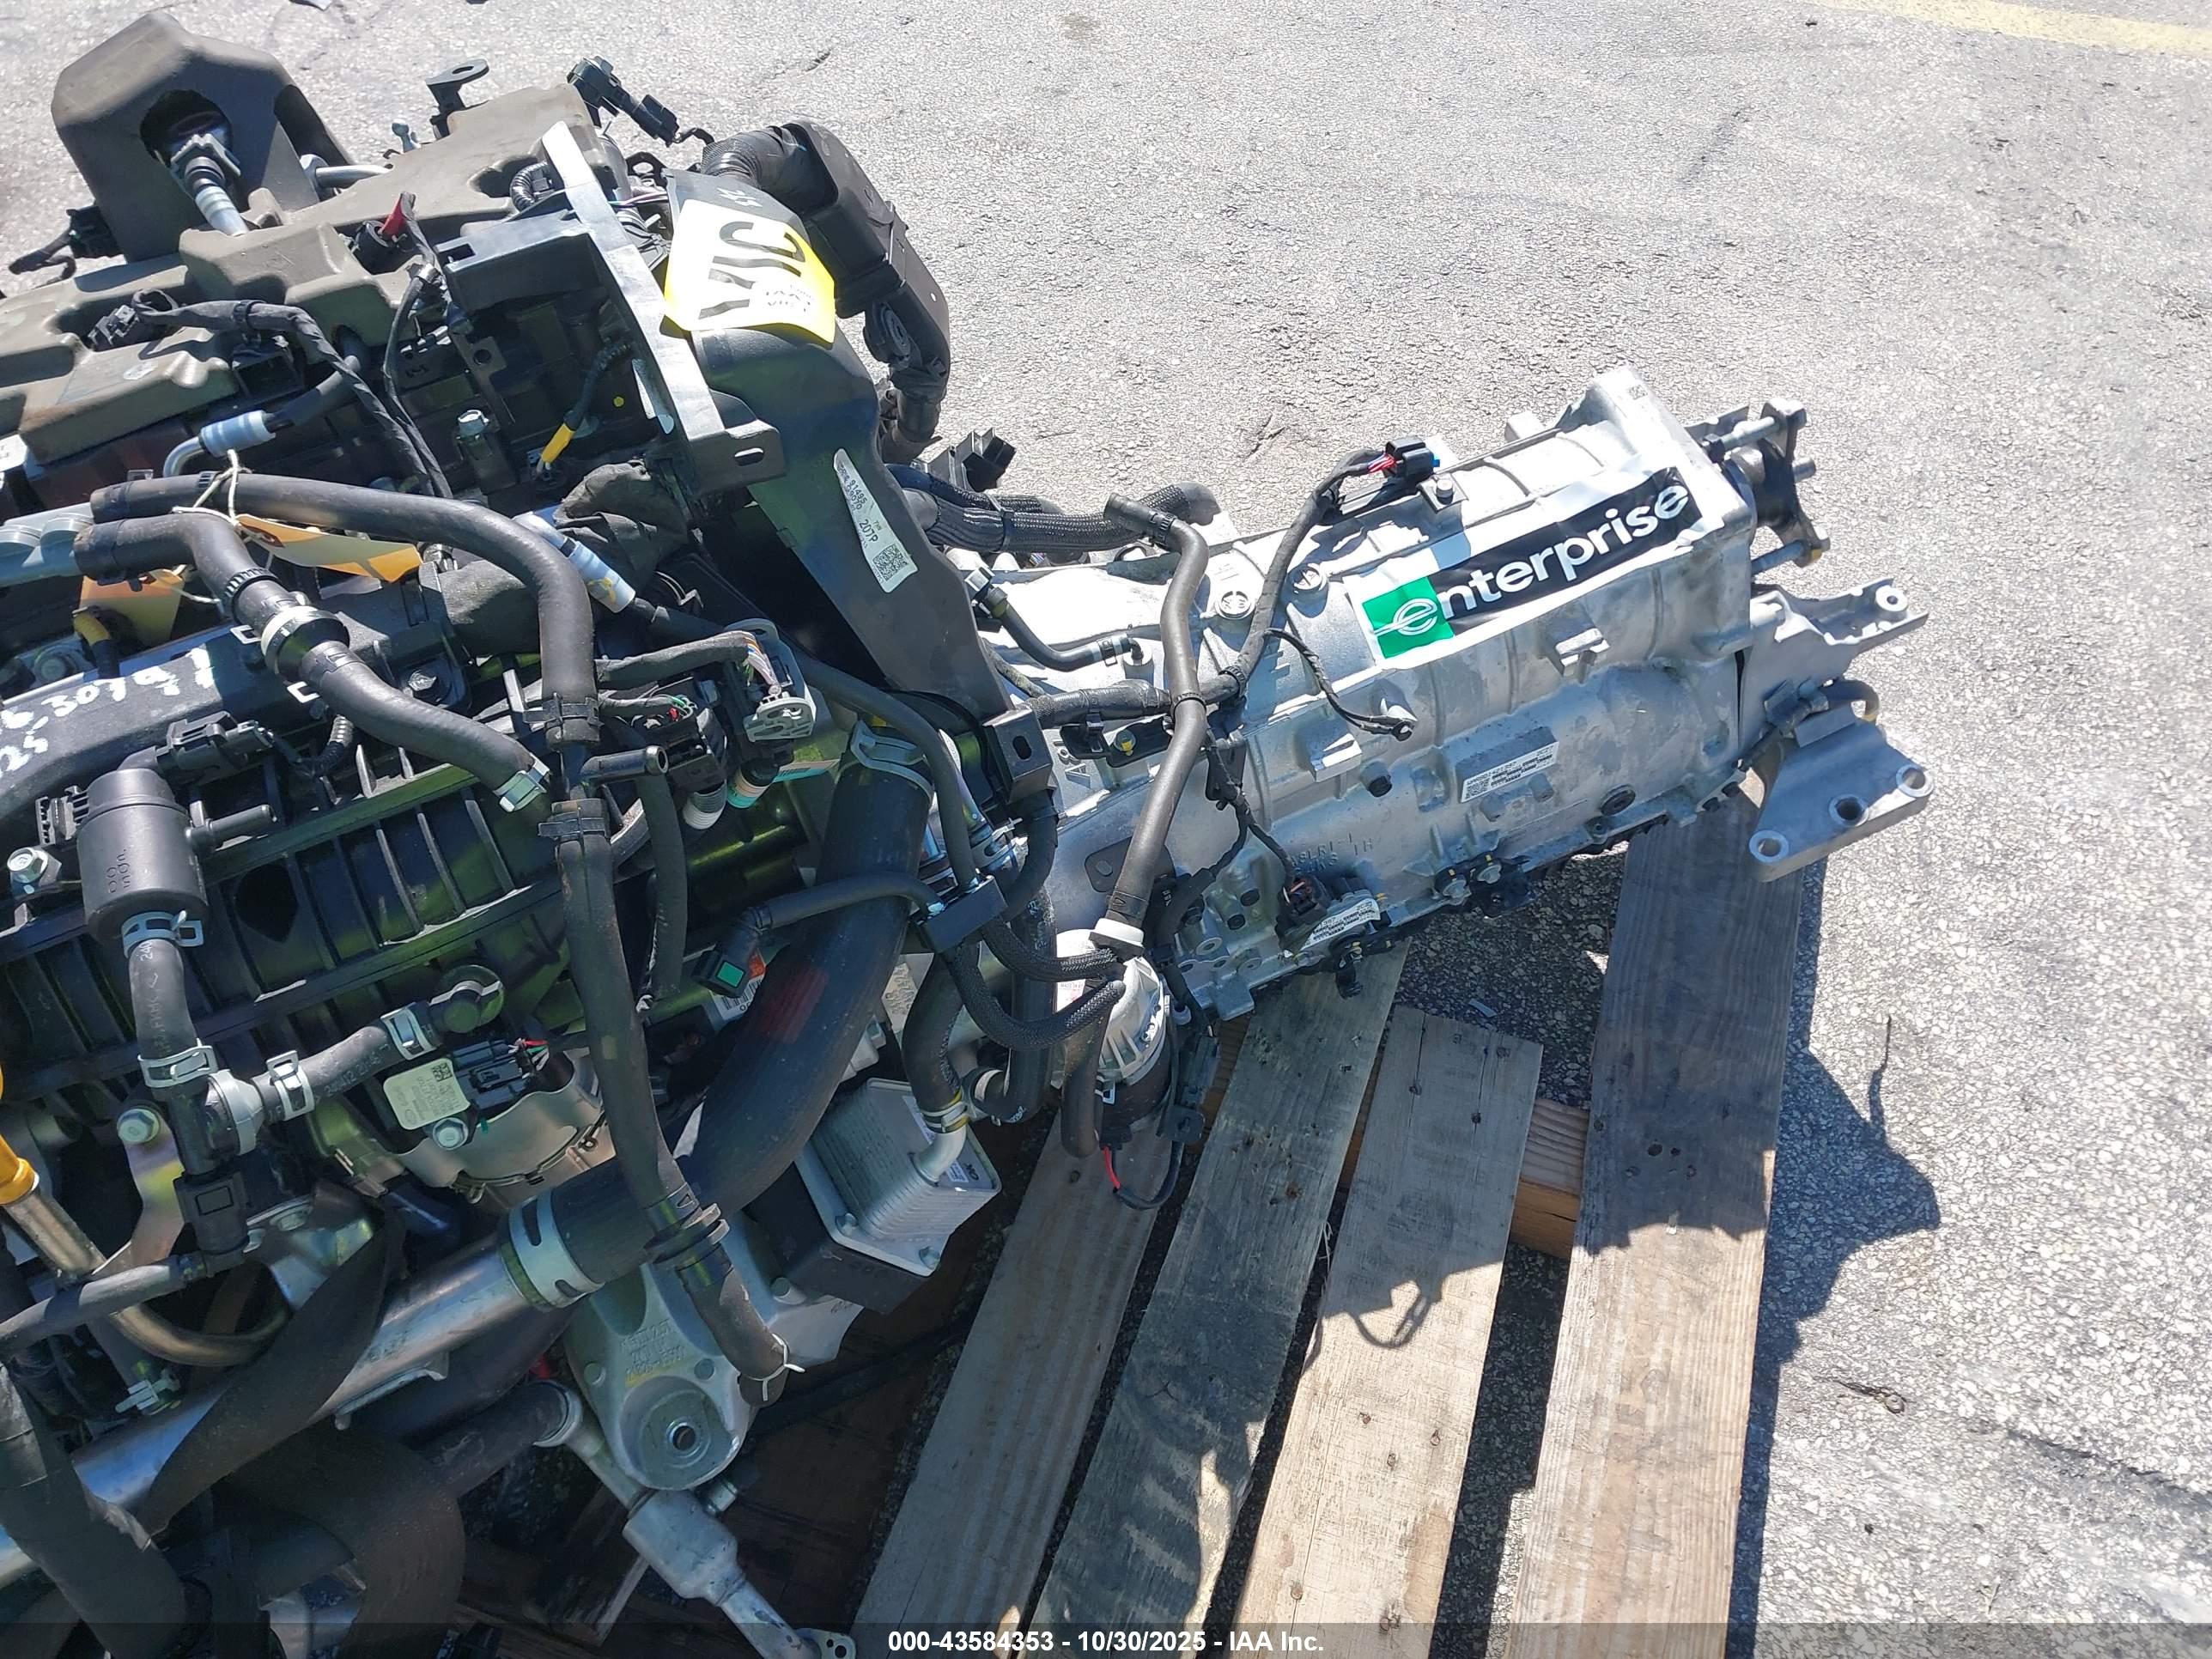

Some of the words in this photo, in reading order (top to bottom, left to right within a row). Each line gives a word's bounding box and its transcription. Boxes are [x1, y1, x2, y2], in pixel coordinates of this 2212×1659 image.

[850, 479, 868, 504] 91495
[859, 519, 879, 543] 207P
[1374, 483, 1690, 637] enterprise
